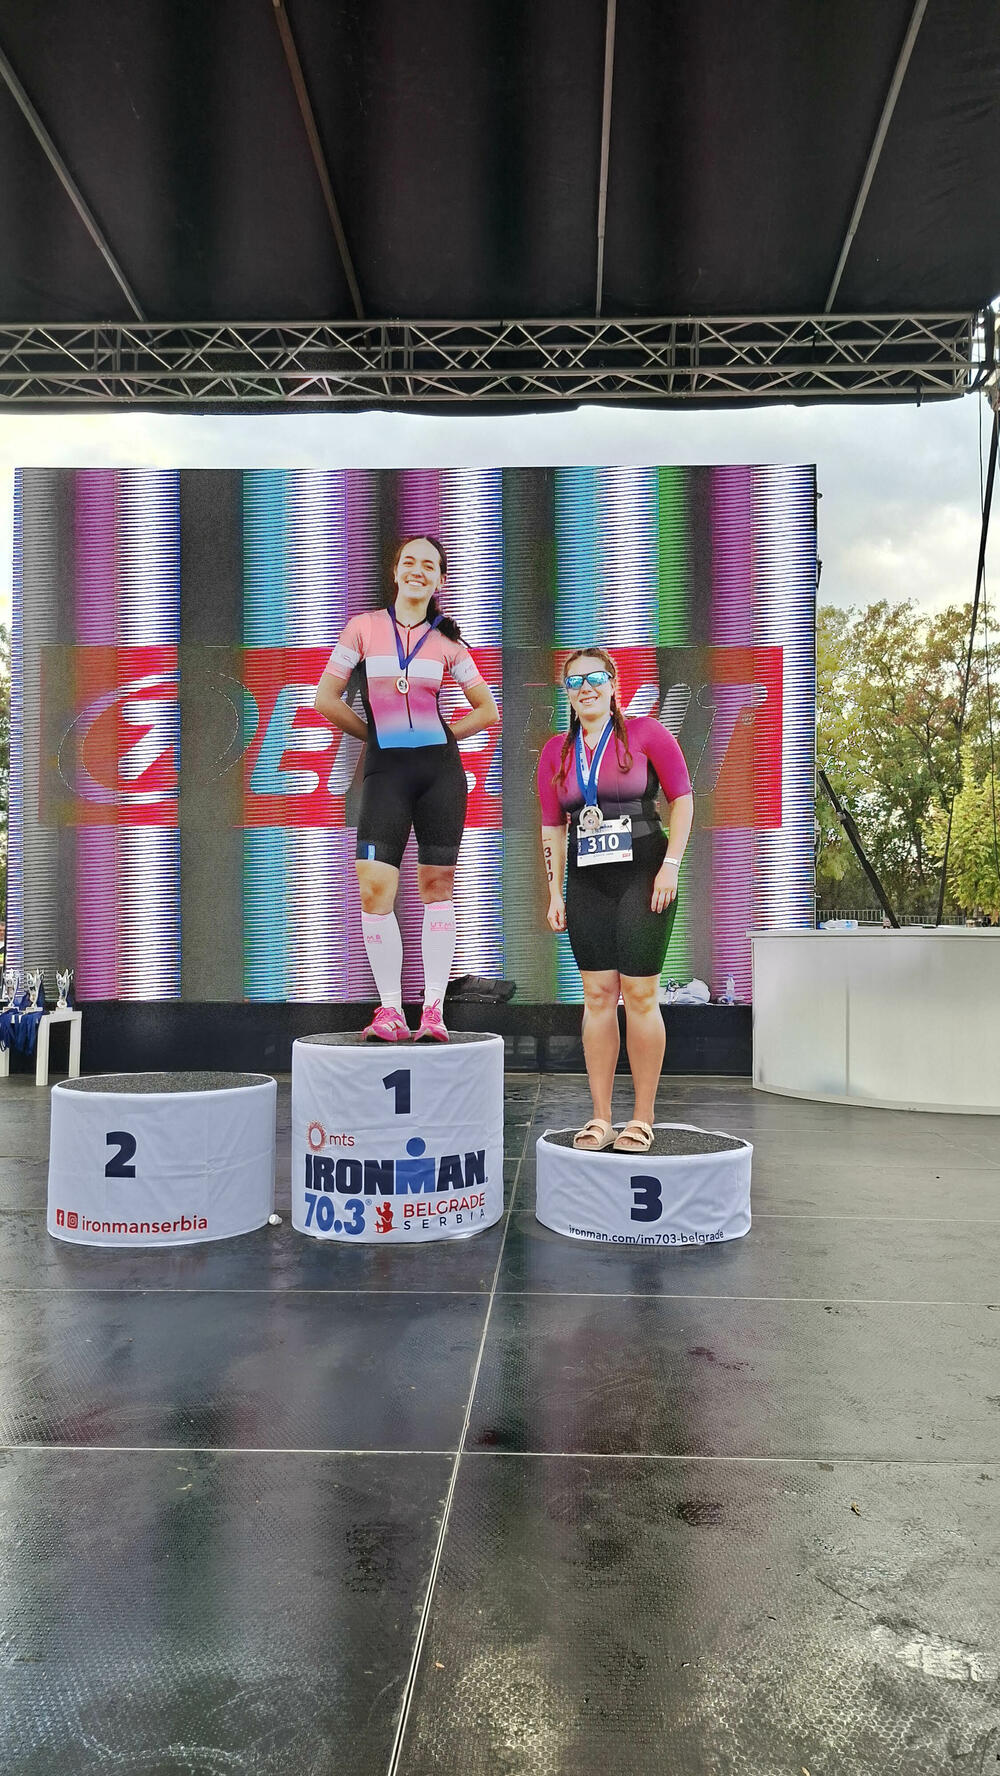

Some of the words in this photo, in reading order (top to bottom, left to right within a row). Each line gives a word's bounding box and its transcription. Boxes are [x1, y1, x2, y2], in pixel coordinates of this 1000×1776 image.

[587, 834, 620, 853] 310
[544, 846, 554, 882] 310
[382, 1069, 411, 1115] 1
[105, 1131, 137, 1178] 2
[329, 1133, 355, 1147] mts
[305, 1142, 486, 1196] IRONMAN
[305, 1192, 366, 1235] 70.3
[403, 1192, 486, 1218] BELGRADE
[630, 1175, 663, 1223] 3
[82, 1214, 208, 1235] ironmanserbia
[404, 1208, 486, 1230] SERBIA
[568, 1224, 724, 1245] ironman.com/im703-belgrade
